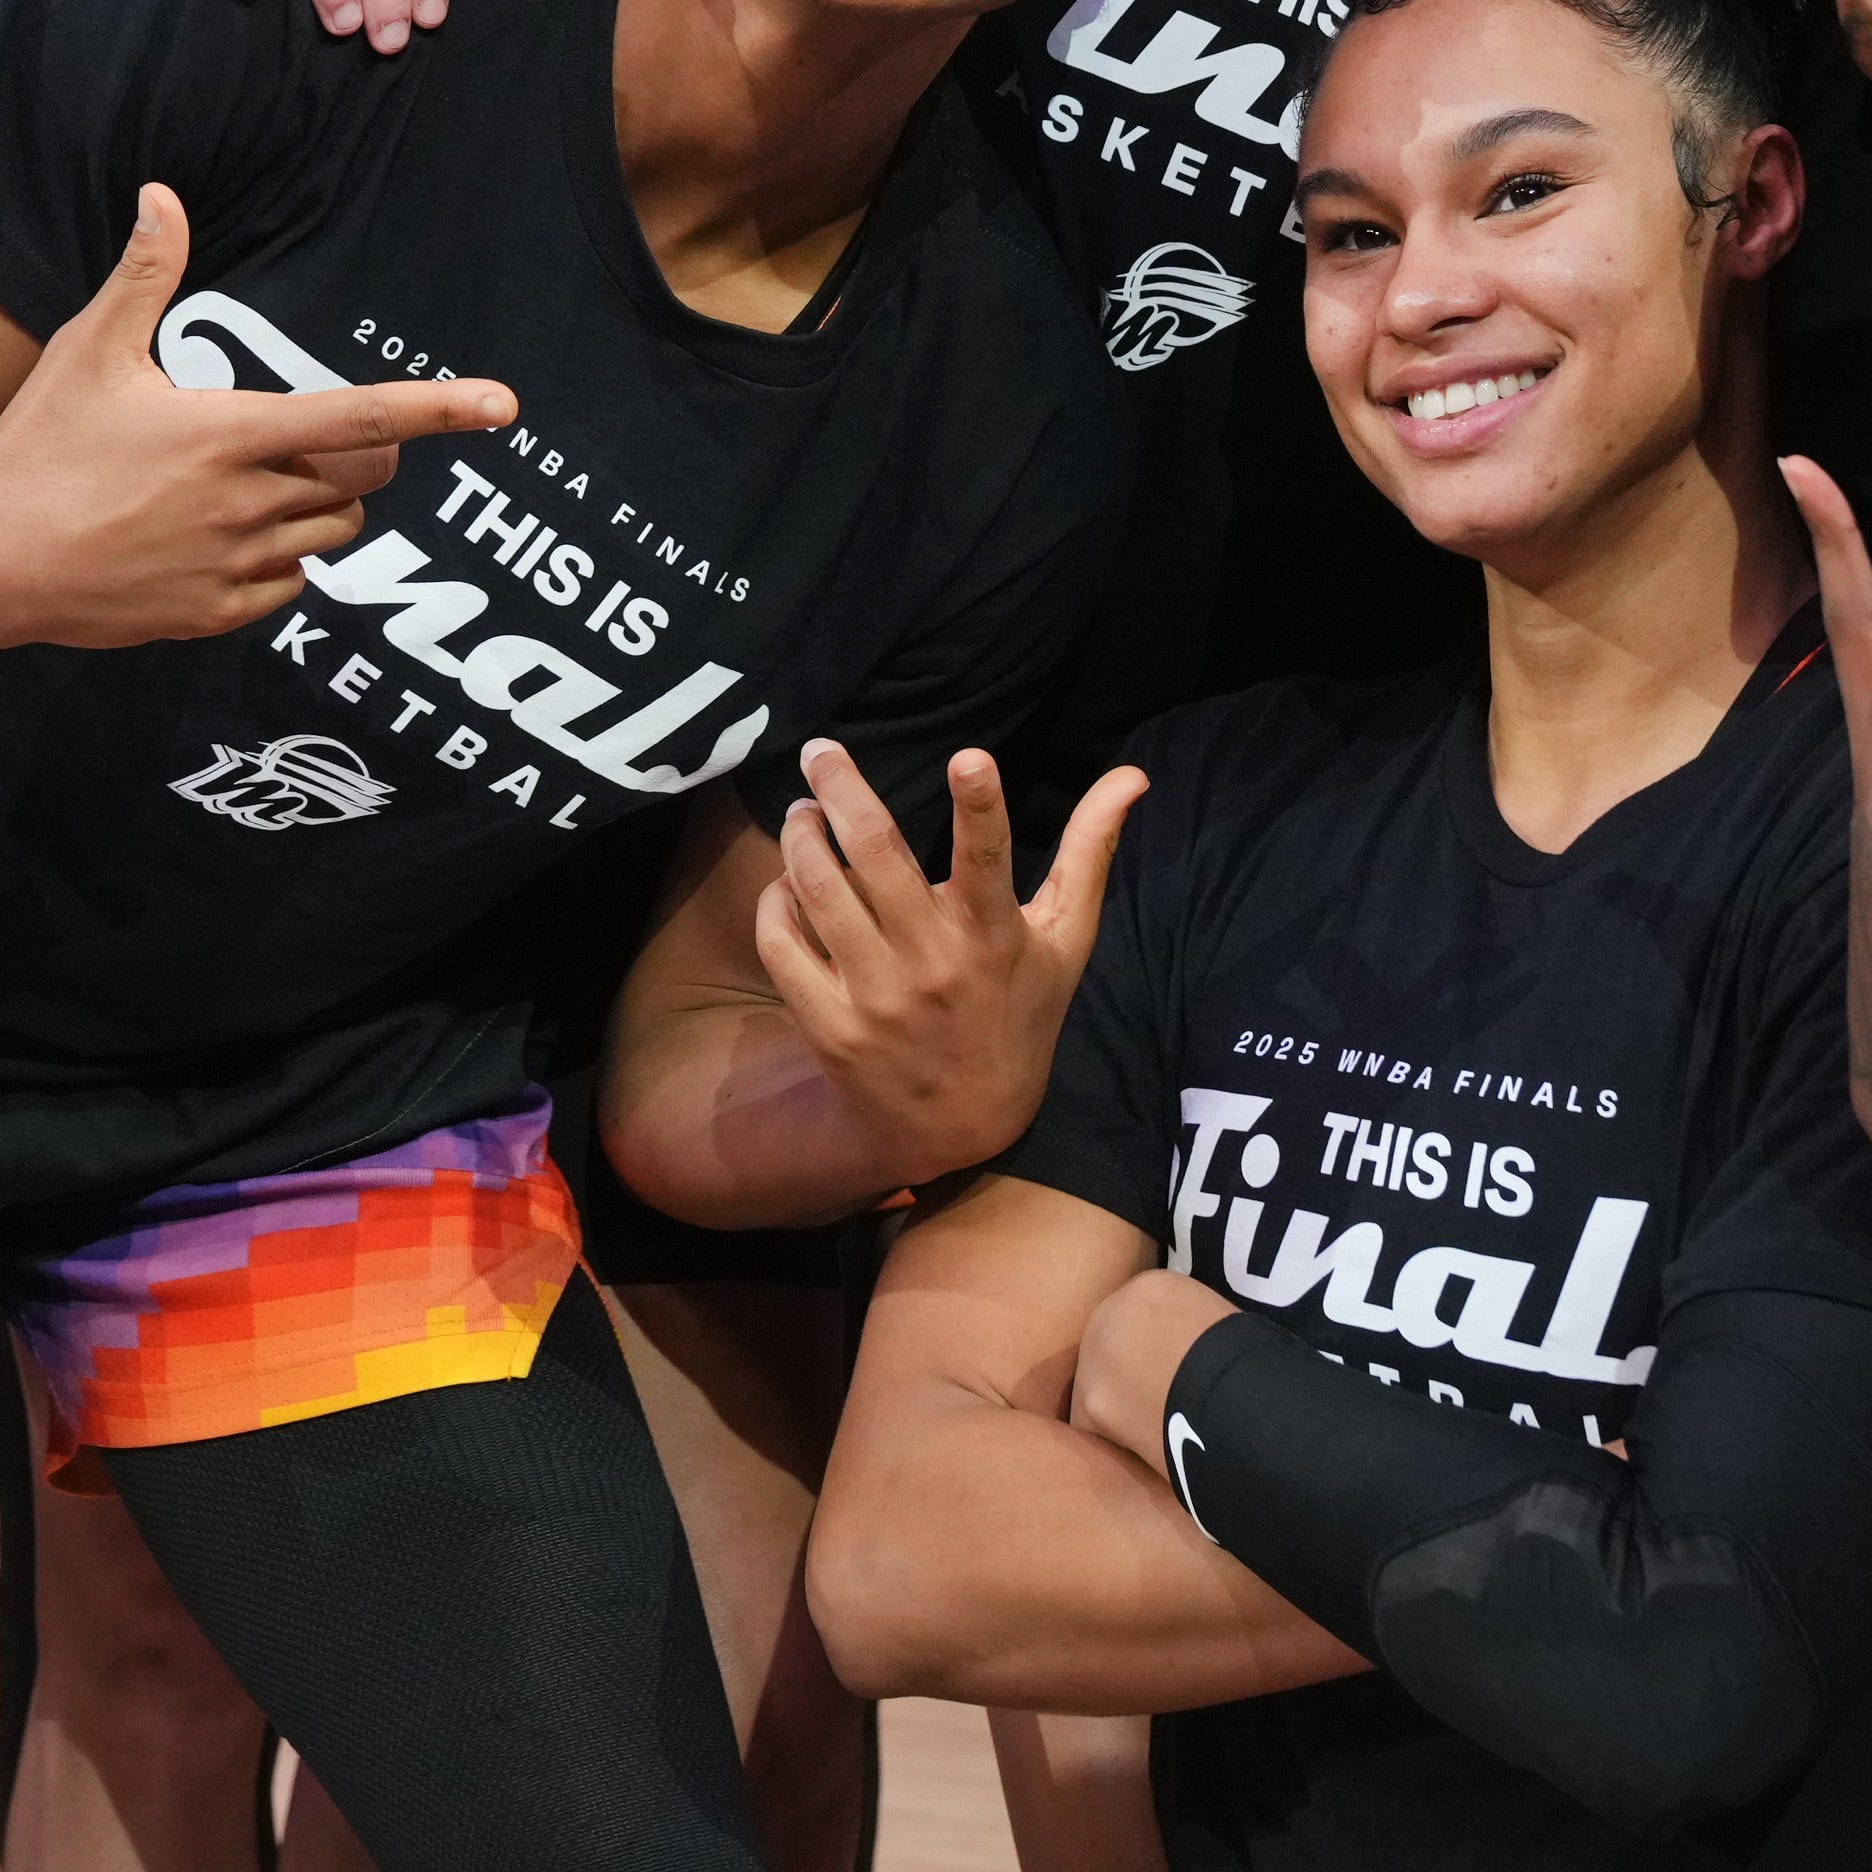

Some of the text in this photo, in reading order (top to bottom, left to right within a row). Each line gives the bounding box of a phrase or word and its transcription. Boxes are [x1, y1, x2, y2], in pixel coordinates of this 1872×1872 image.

[435, 458, 670, 657] THIS IS
[486, 426, 590, 499] NBA
[610, 503, 751, 603] FINALS
[1233, 1030, 1620, 1119] 2025 WNBA FINALS
[1167, 1087, 1659, 1387] Final
[1320, 1111, 1536, 1218] THIS IS
